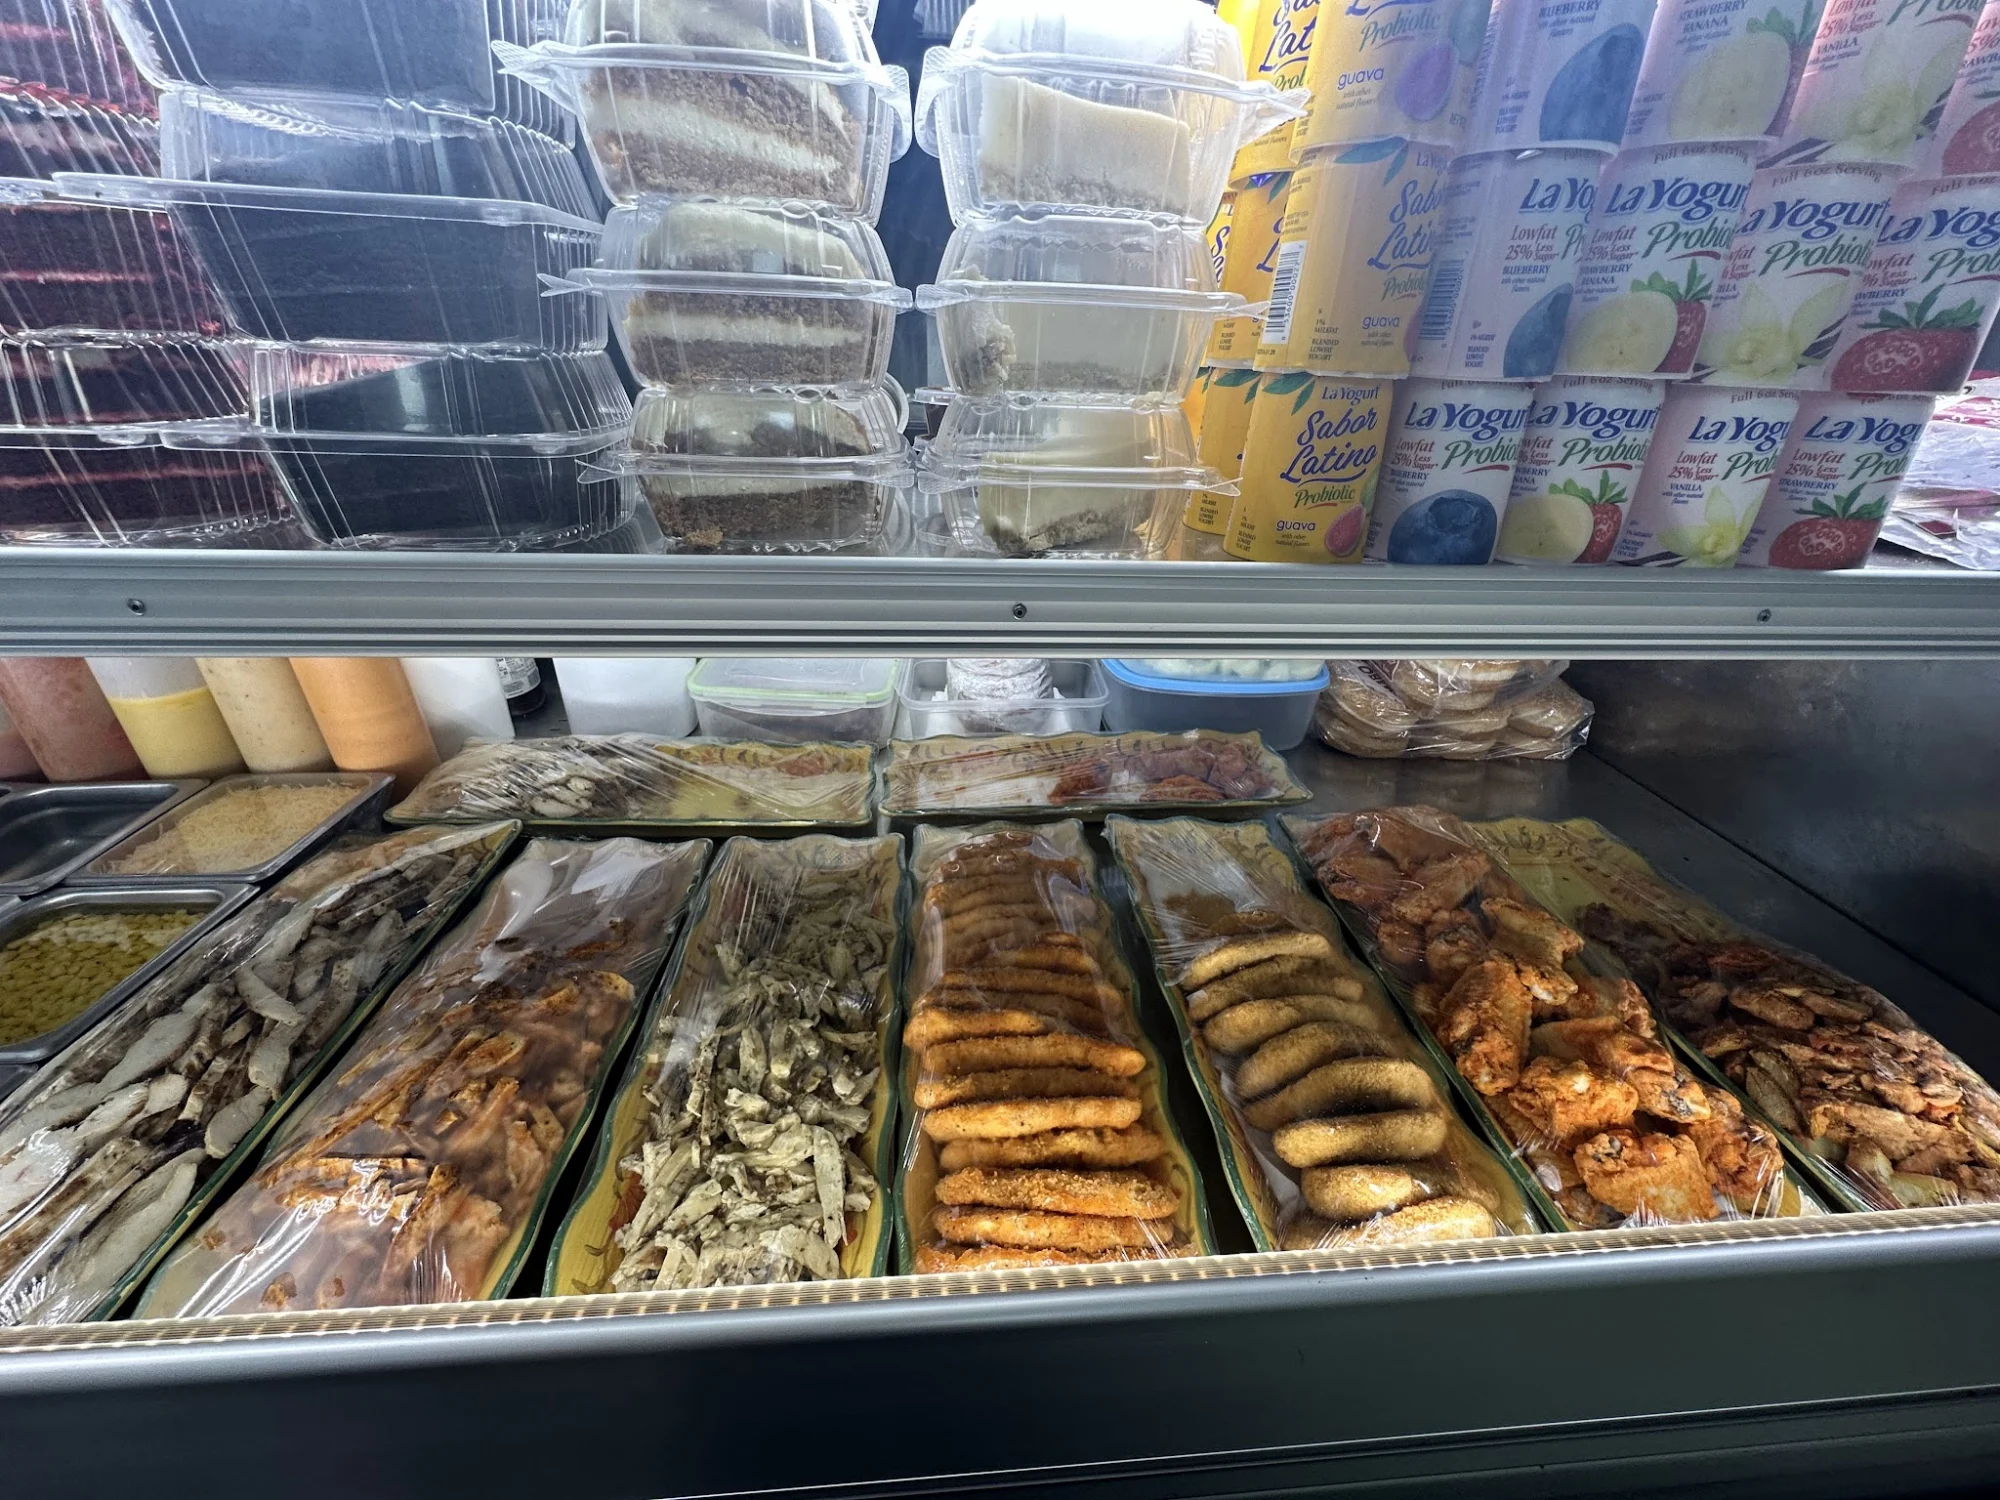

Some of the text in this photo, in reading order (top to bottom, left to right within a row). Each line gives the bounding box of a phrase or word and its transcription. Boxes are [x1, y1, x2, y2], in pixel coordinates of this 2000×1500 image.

[1359, 8, 1441, 52] Probiotic
[1337, 68, 1385, 90] guava
[1772, 170, 1799, 187] Full
[1835, 163, 1883, 184] Serving
[1519, 178, 1561, 211] La
[1604, 183, 1646, 214] La
[1735, 198, 1892, 241] a Yogurt
[1878, 215, 1923, 243] La
[1510, 223, 1558, 244] Lowfat
[1504, 243, 1555, 261] 25% Less
[1502, 264, 1552, 276] BLUEBERRY
[1362, 316, 1400, 330] guava
[1321, 382, 1382, 406] La Yogurt
[1730, 391, 1753, 404] Full
[1404, 401, 1439, 427] La
[1525, 399, 1663, 442] La Yogurt
[1296, 407, 1378, 446] Sabor
[1687, 415, 1728, 441] La
[1803, 415, 1856, 440] La
[1395, 437, 1436, 456] Lowfat
[1530, 451, 1549, 460] Less
[1557, 435, 1649, 468] Probiot
[1792, 448, 1847, 467] Lowfat
[1279, 441, 1378, 484] Latino
[1413, 454, 1432, 462] Less
[1676, 450, 1719, 468] Lowfat
[1667, 466, 1712, 480] 25% Less
[1784, 463, 1840, 478] 25% Less
[1669, 483, 1703, 492] VANILLA
[1778, 477, 1839, 491] STRAWBERRY
[1294, 484, 1356, 509] Probiotic
[1276, 519, 1316, 532] guava
